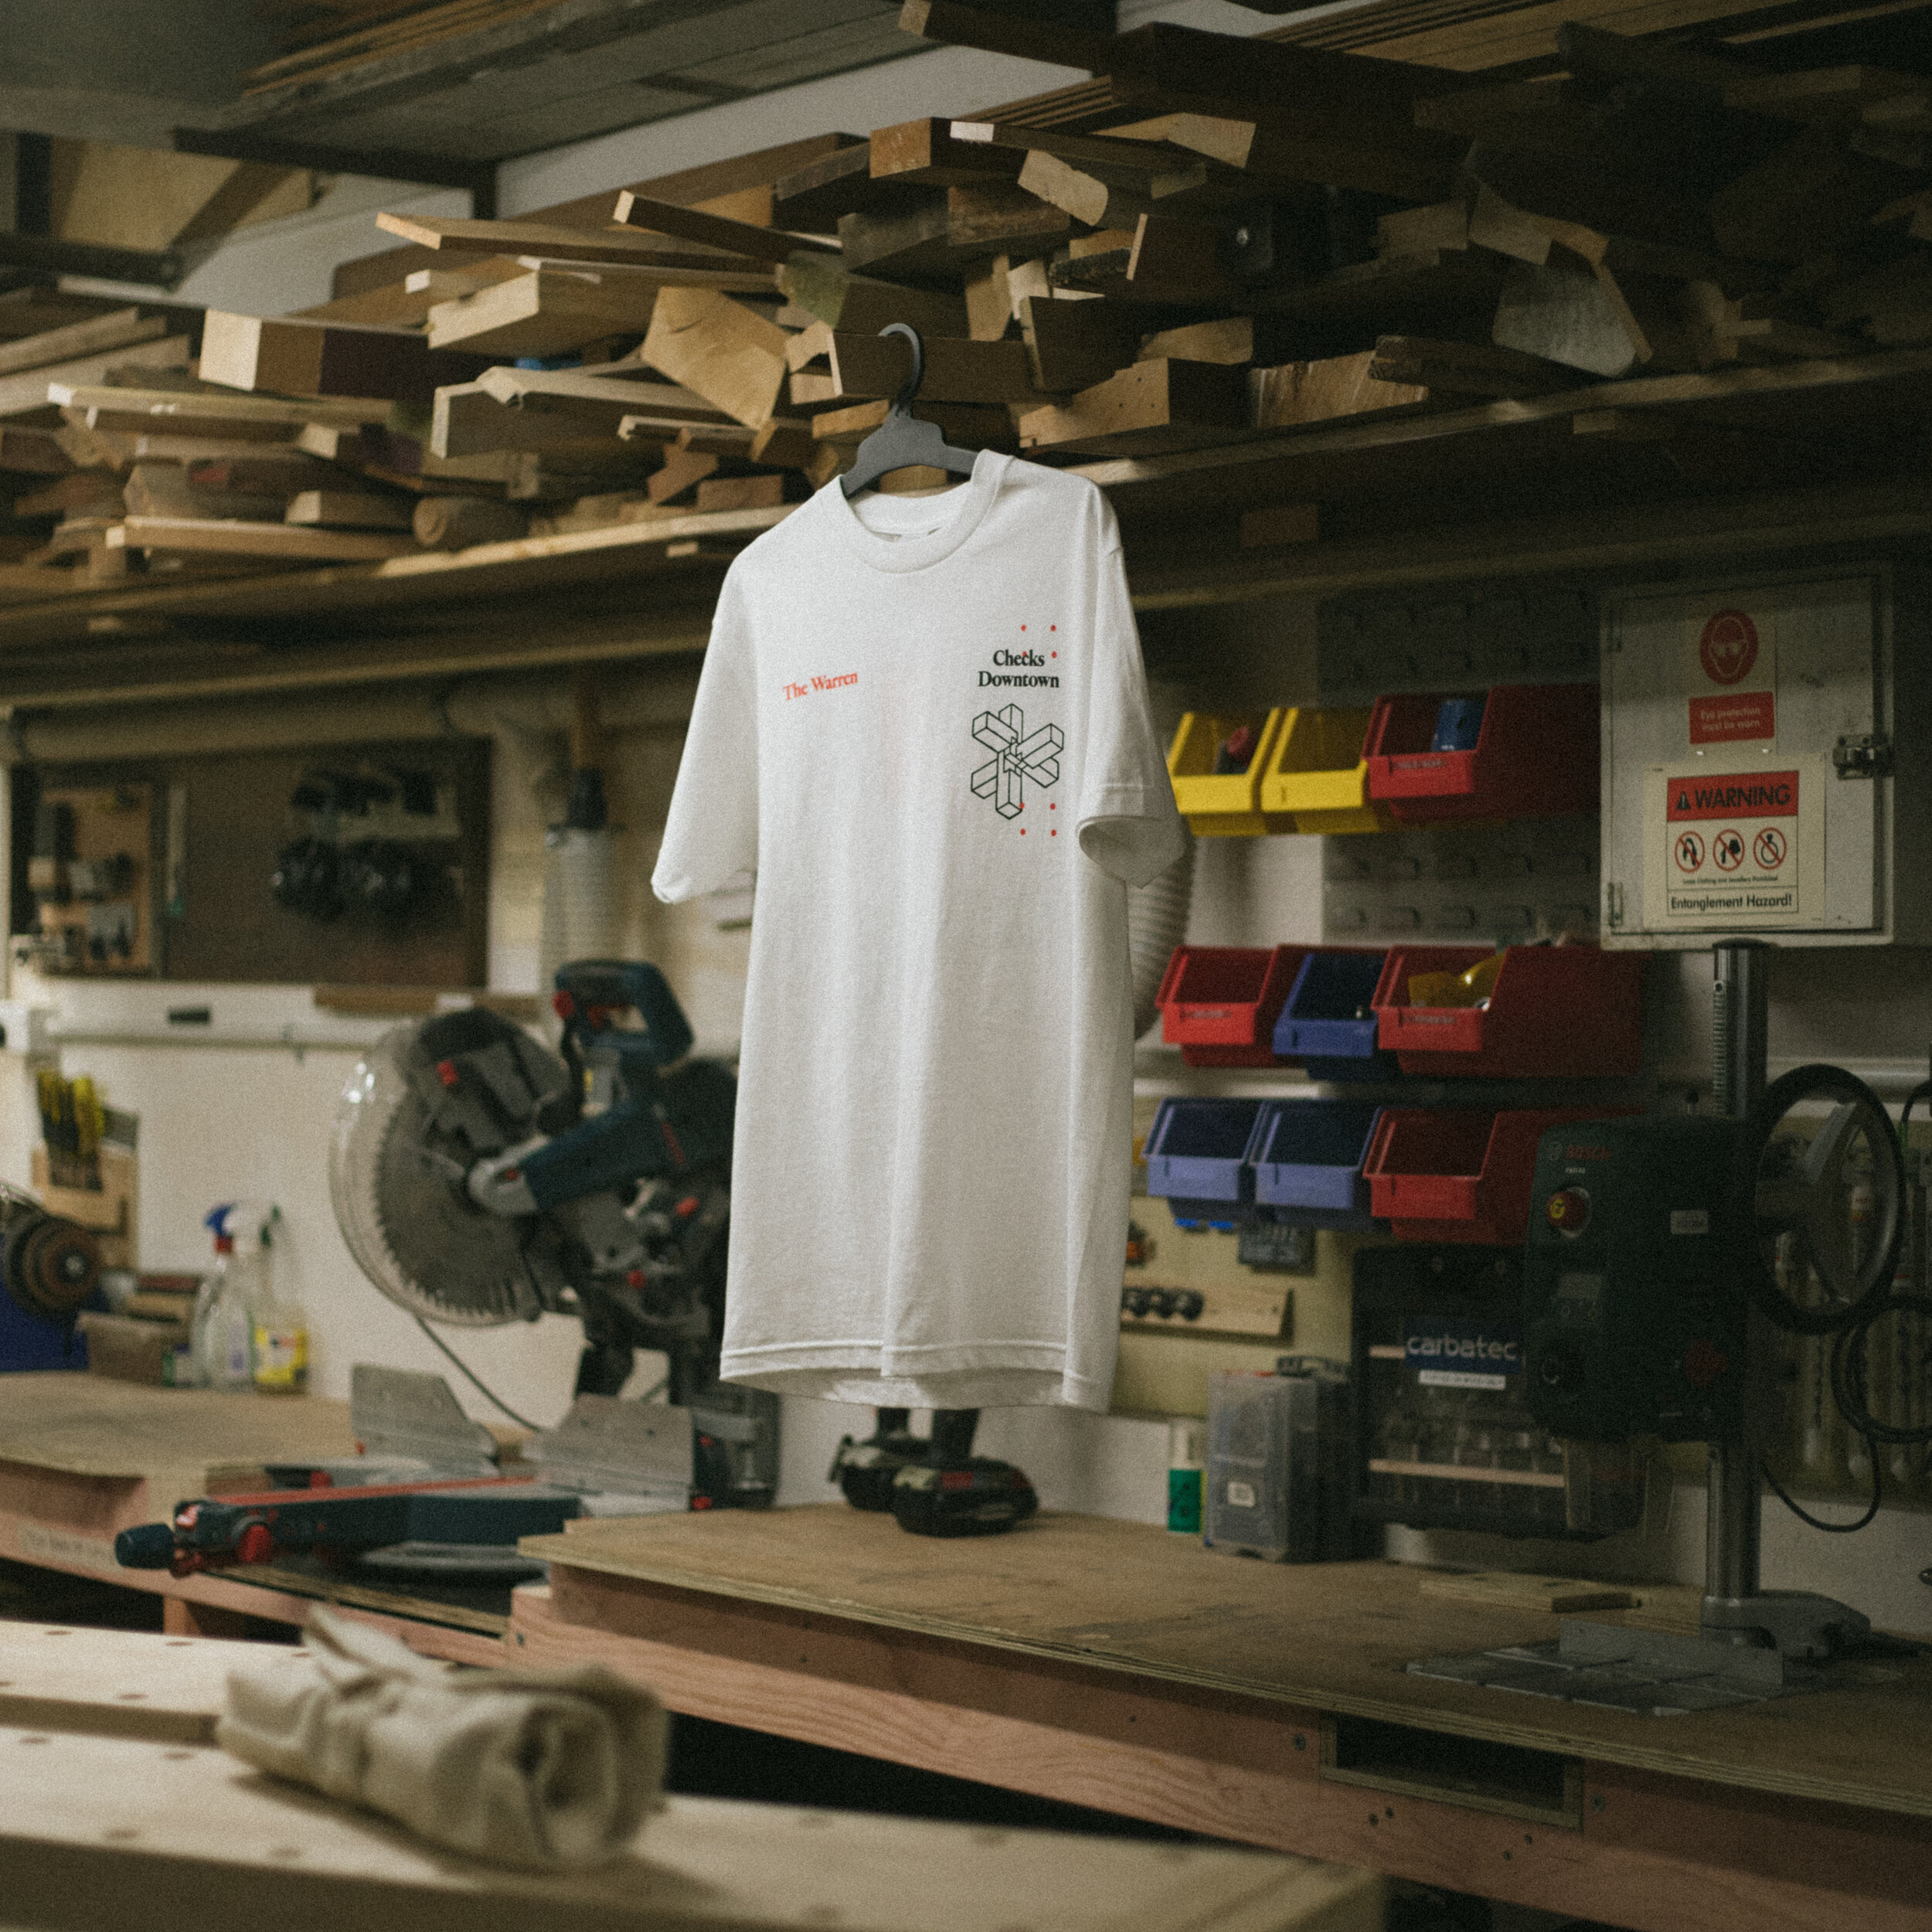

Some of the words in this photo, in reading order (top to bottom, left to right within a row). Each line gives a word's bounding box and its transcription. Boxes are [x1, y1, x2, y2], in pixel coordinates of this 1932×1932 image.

[993, 649, 1045, 666] Checks
[783, 682, 808, 700] The
[811, 672, 858, 692] Warren
[978, 671, 1060, 688] Downtown
[1695, 784, 1791, 808] WARNING
[1671, 894, 1743, 911] Entanglement
[1747, 893, 1792, 907] Hazard!
[1566, 1145, 1612, 1161] BOSCH
[1406, 1333, 1518, 1360] carbatec
